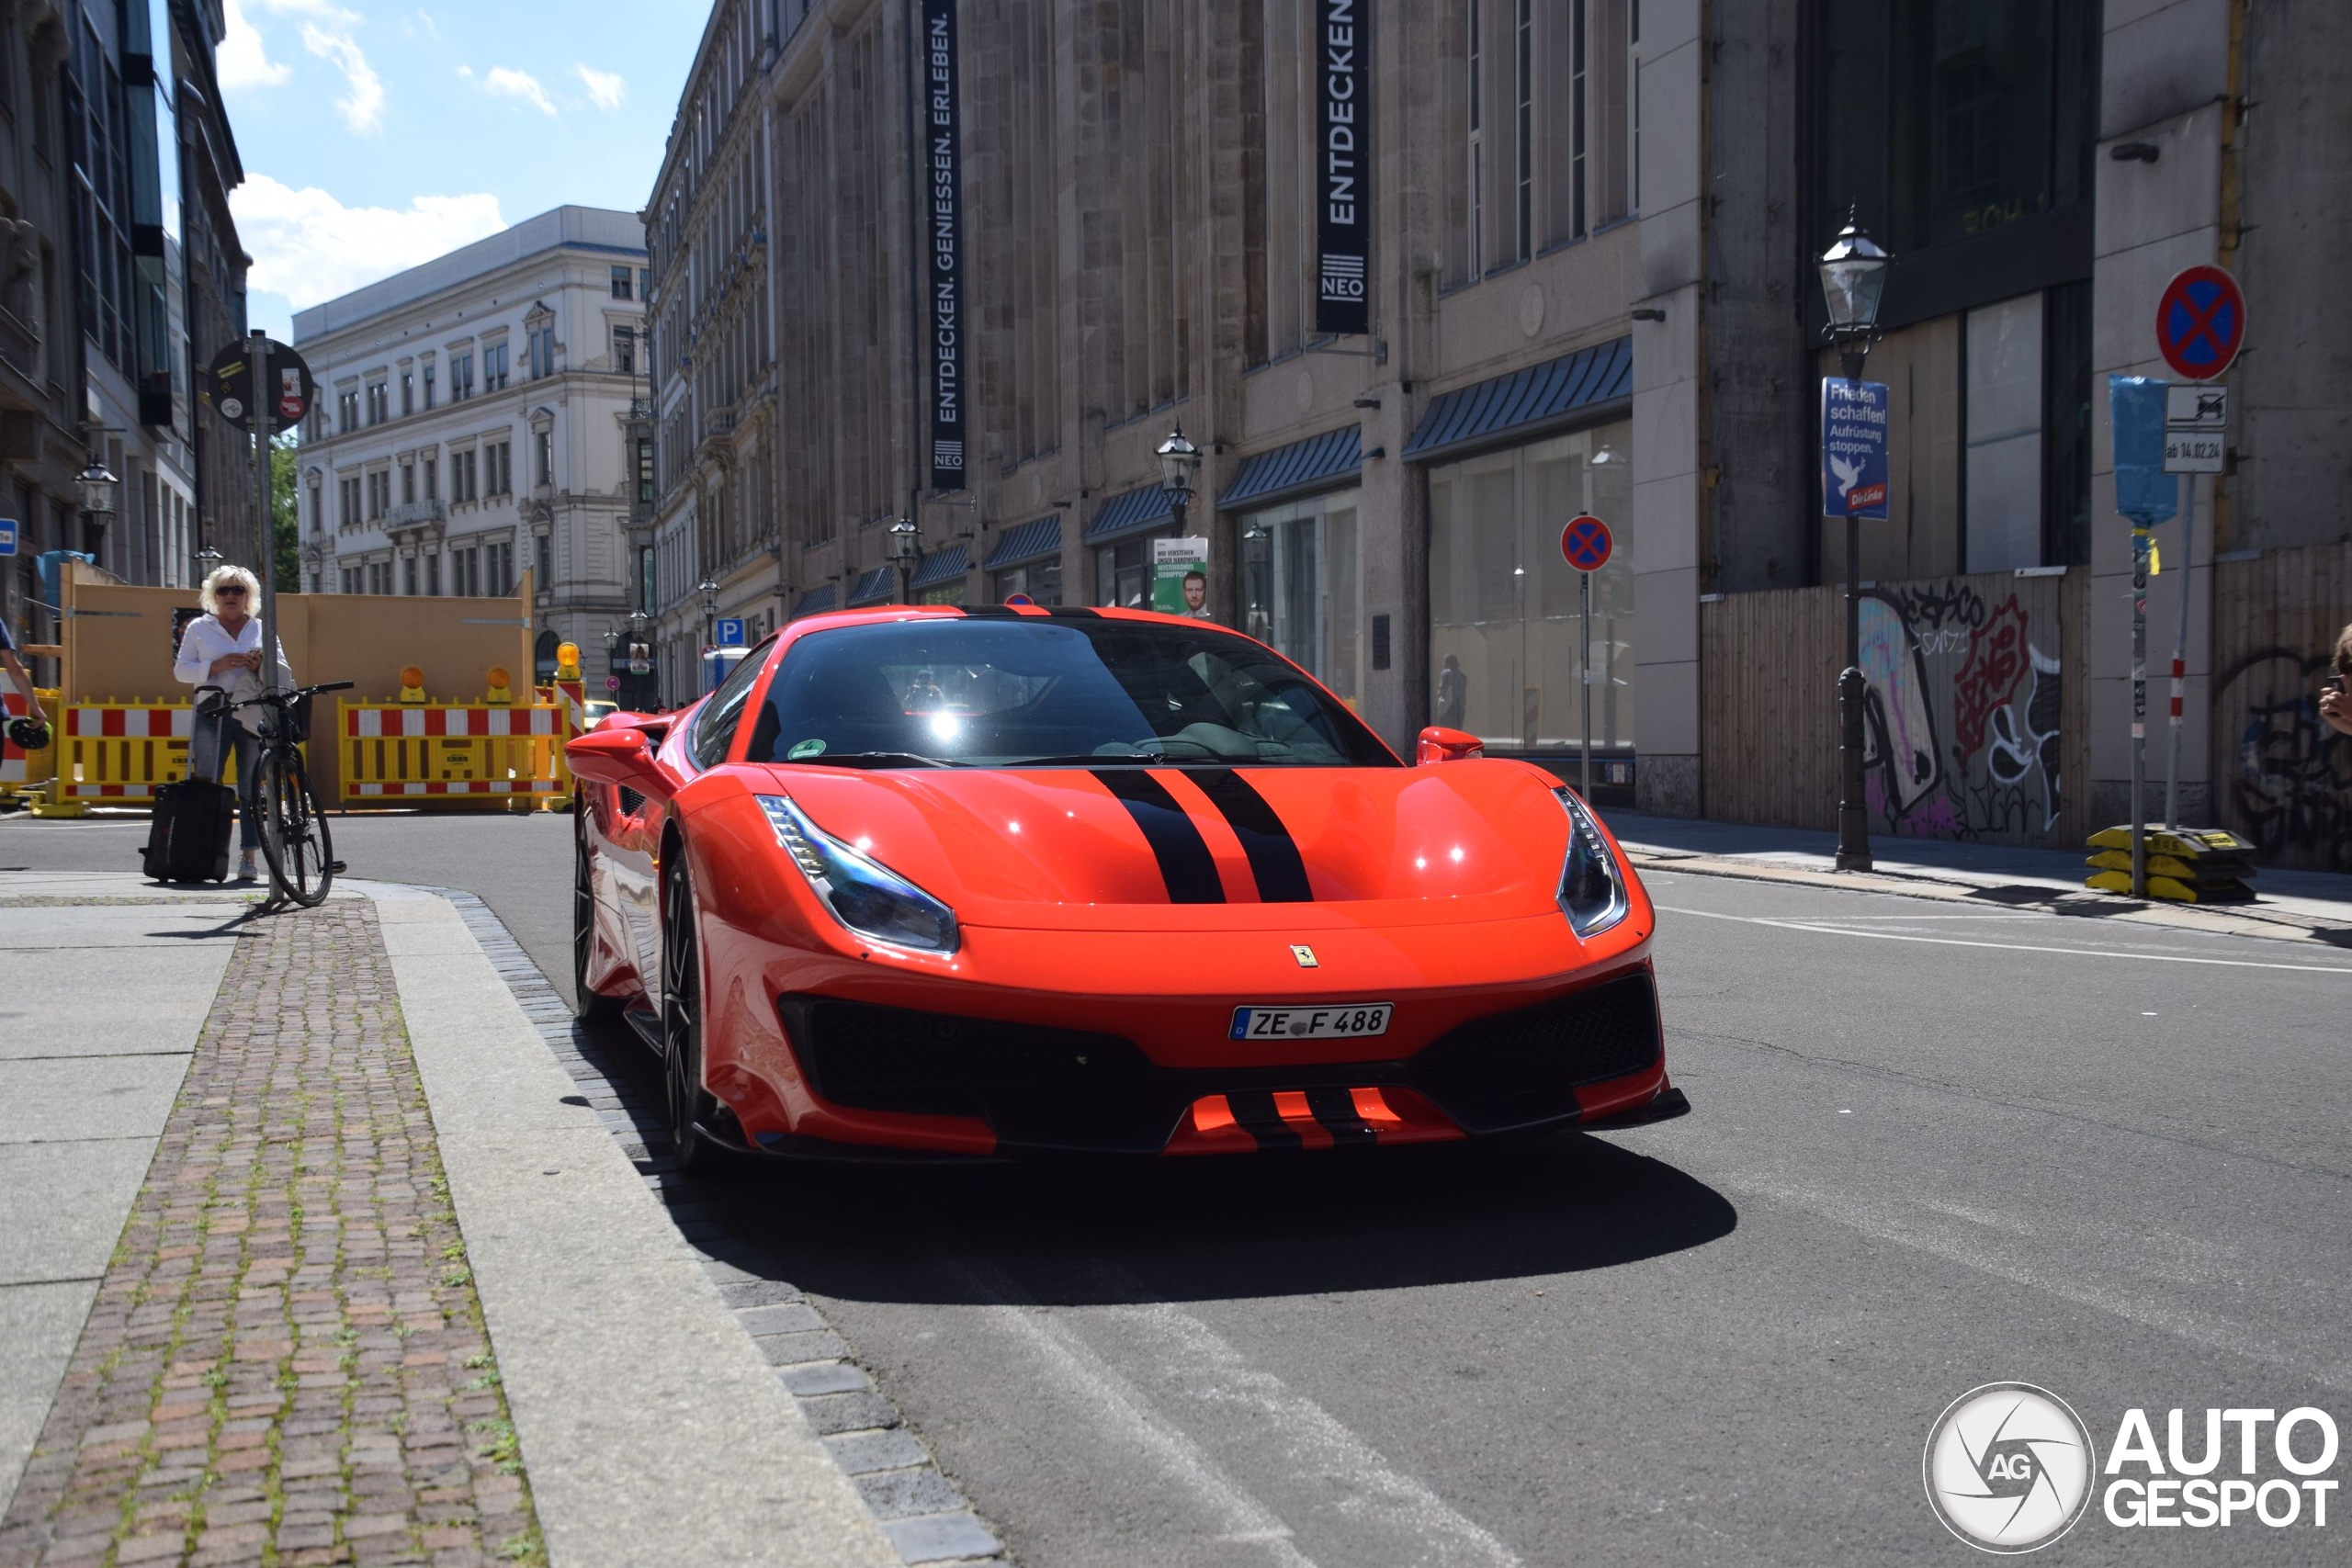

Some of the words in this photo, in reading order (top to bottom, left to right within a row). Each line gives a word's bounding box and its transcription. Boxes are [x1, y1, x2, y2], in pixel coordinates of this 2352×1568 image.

[931, 13, 951, 126] ERLEBEN.
[1328, 0, 1355, 225] ENTDECKEN
[933, 132, 955, 271] GENIESSEN.
[1321, 277, 1364, 297] NEO
[937, 276, 956, 423] ENTDECKEN.
[1830, 384, 1876, 404] Frieden
[1830, 404, 1886, 424] schaffen!
[1829, 424, 1883, 444] Aufrüstung
[1829, 441, 1873, 455] stoppen.
[2166, 443, 2178, 458] ab
[2181, 443, 2221, 458] 14.02.24
[934, 455, 963, 467] NEO
[723, 622, 738, 642] P
[803, 740, 814, 750] 4
[1253, 1013, 1290, 1035] ZE
[1308, 1012, 1329, 1034] F
[1334, 1010, 1384, 1033] 488
